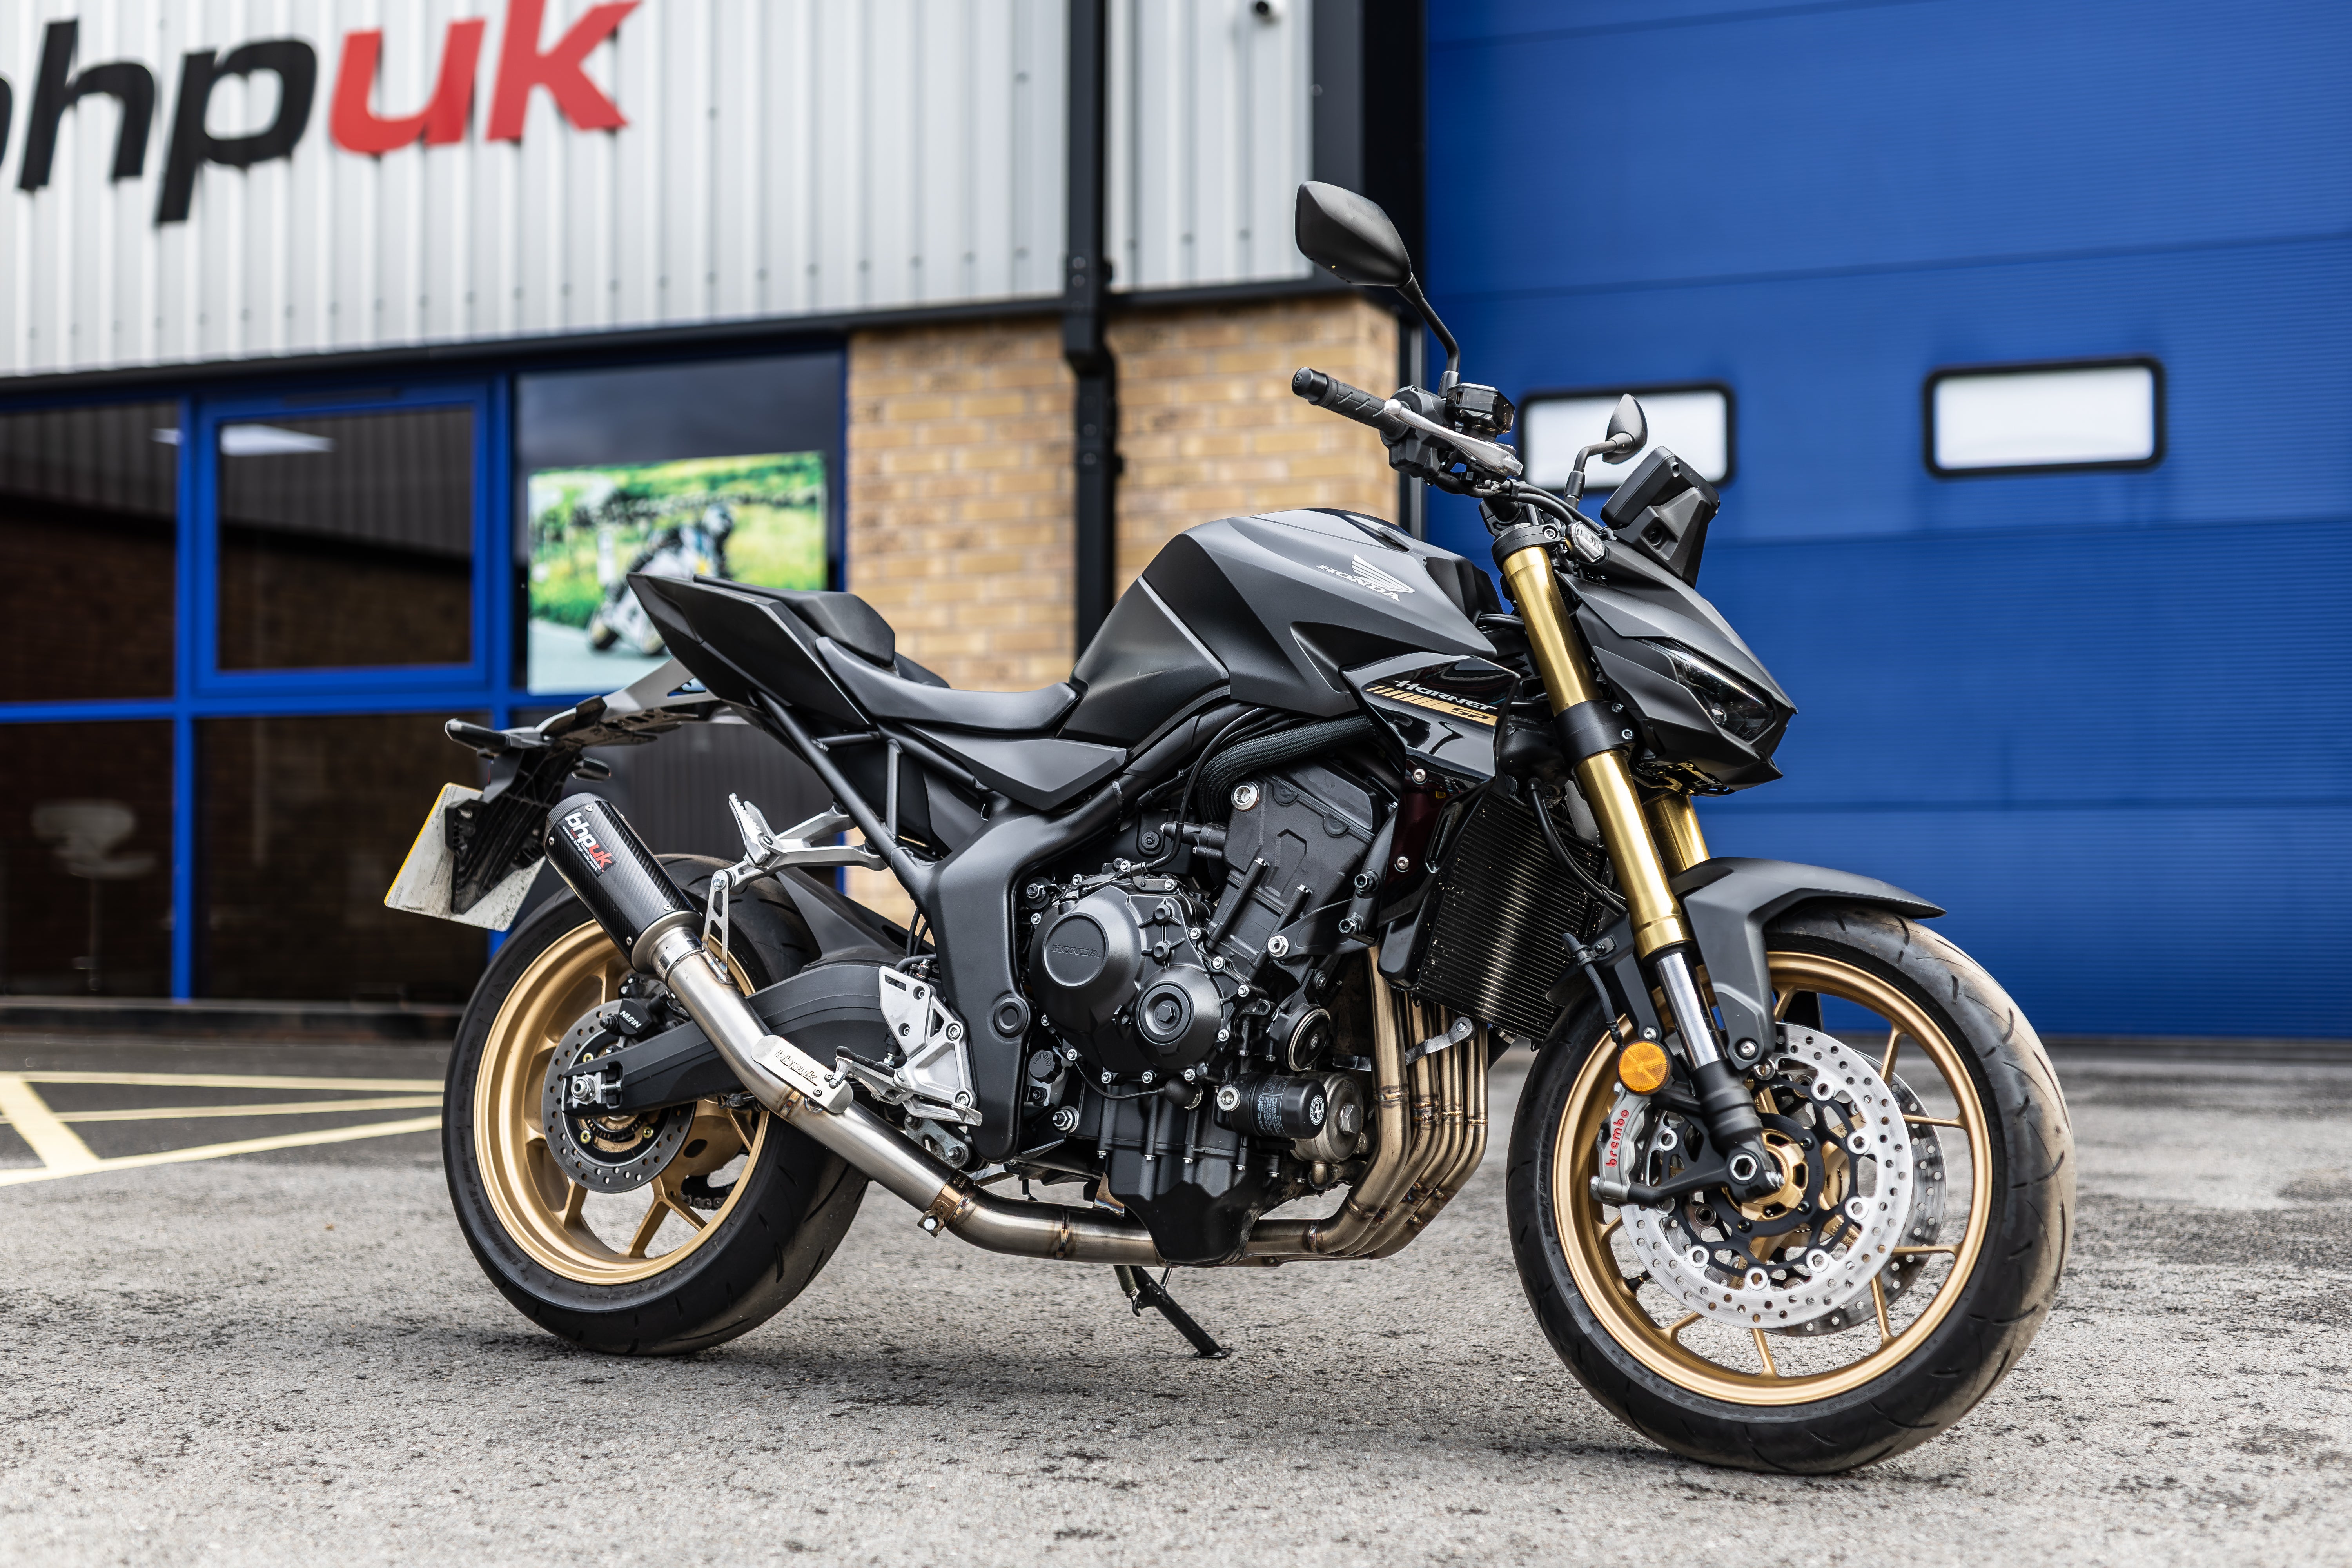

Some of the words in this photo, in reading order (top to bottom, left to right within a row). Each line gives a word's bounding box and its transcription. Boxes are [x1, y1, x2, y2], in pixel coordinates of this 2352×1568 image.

[0, 0, 642, 228] hpuk
[1316, 564, 1400, 601] HONDA
[1449, 708, 1490, 719] SP
[565, 811, 612, 868] bhpuk
[1051, 944, 1100, 958] HONDA
[1605, 1109, 1629, 1168] brembo
